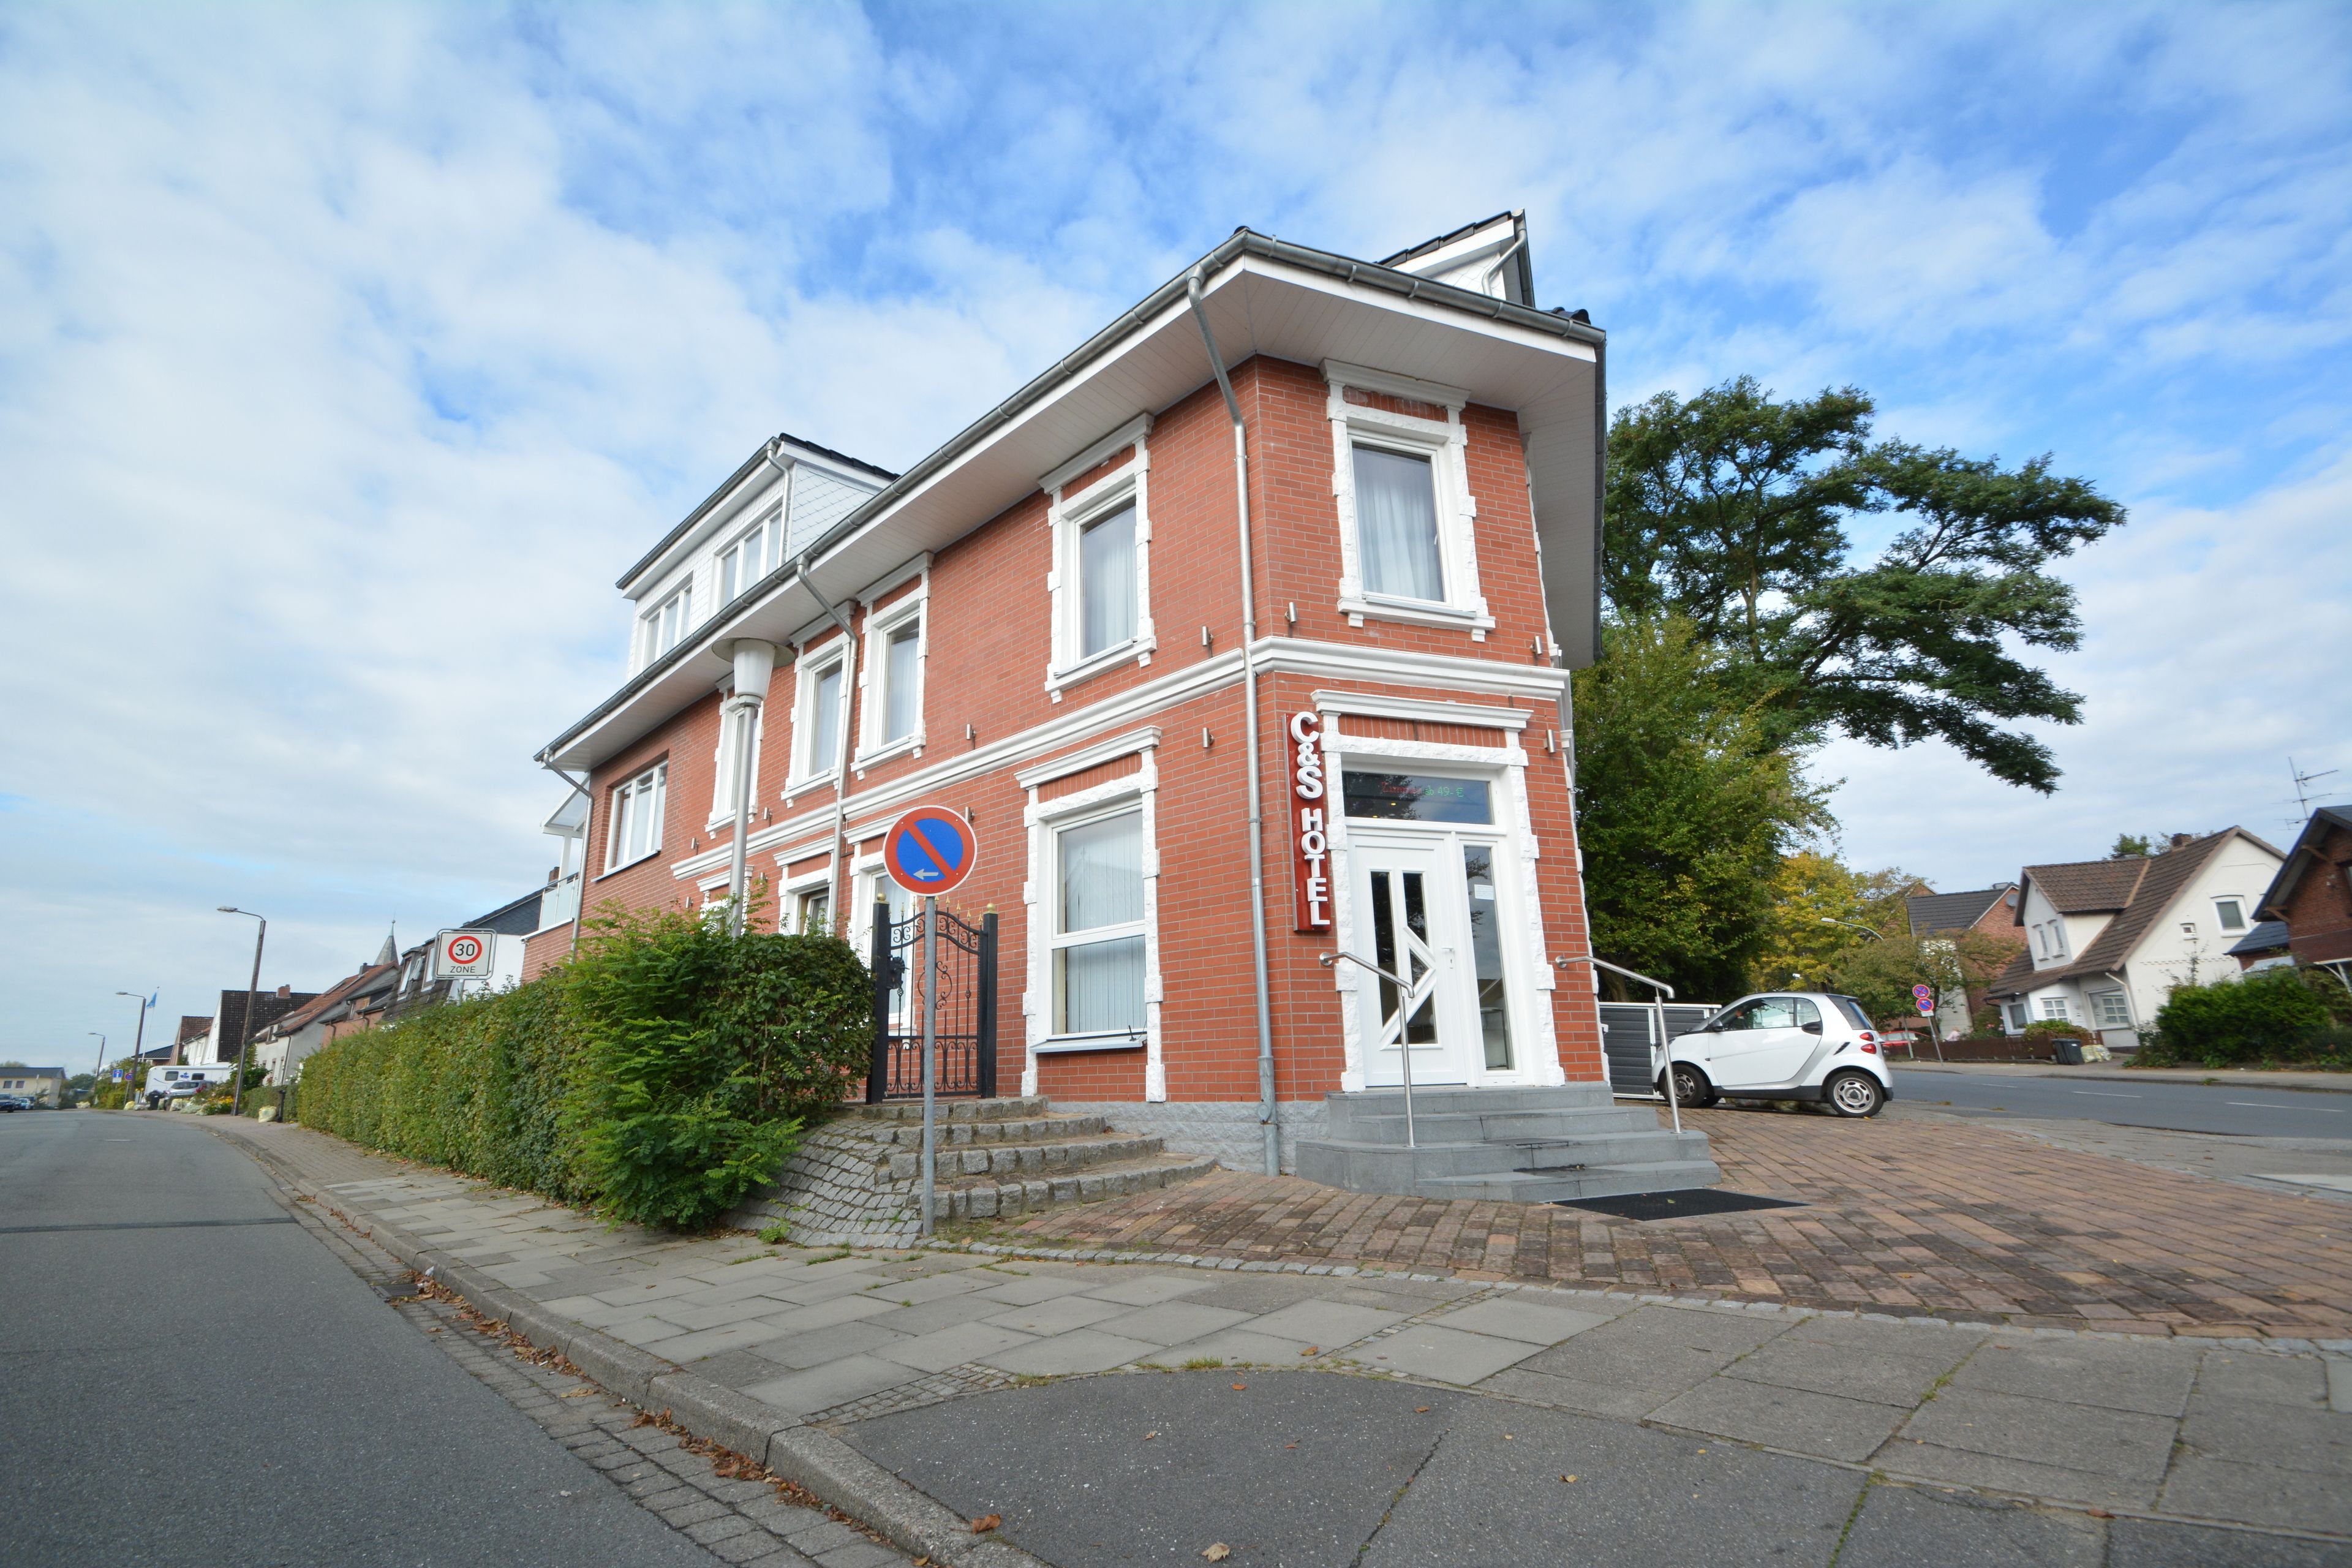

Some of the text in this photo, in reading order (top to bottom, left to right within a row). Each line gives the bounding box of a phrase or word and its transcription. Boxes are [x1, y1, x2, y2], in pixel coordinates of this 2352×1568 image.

[1291, 711, 1330, 925] C&S HOTEL
[455, 943, 475, 957] 30
